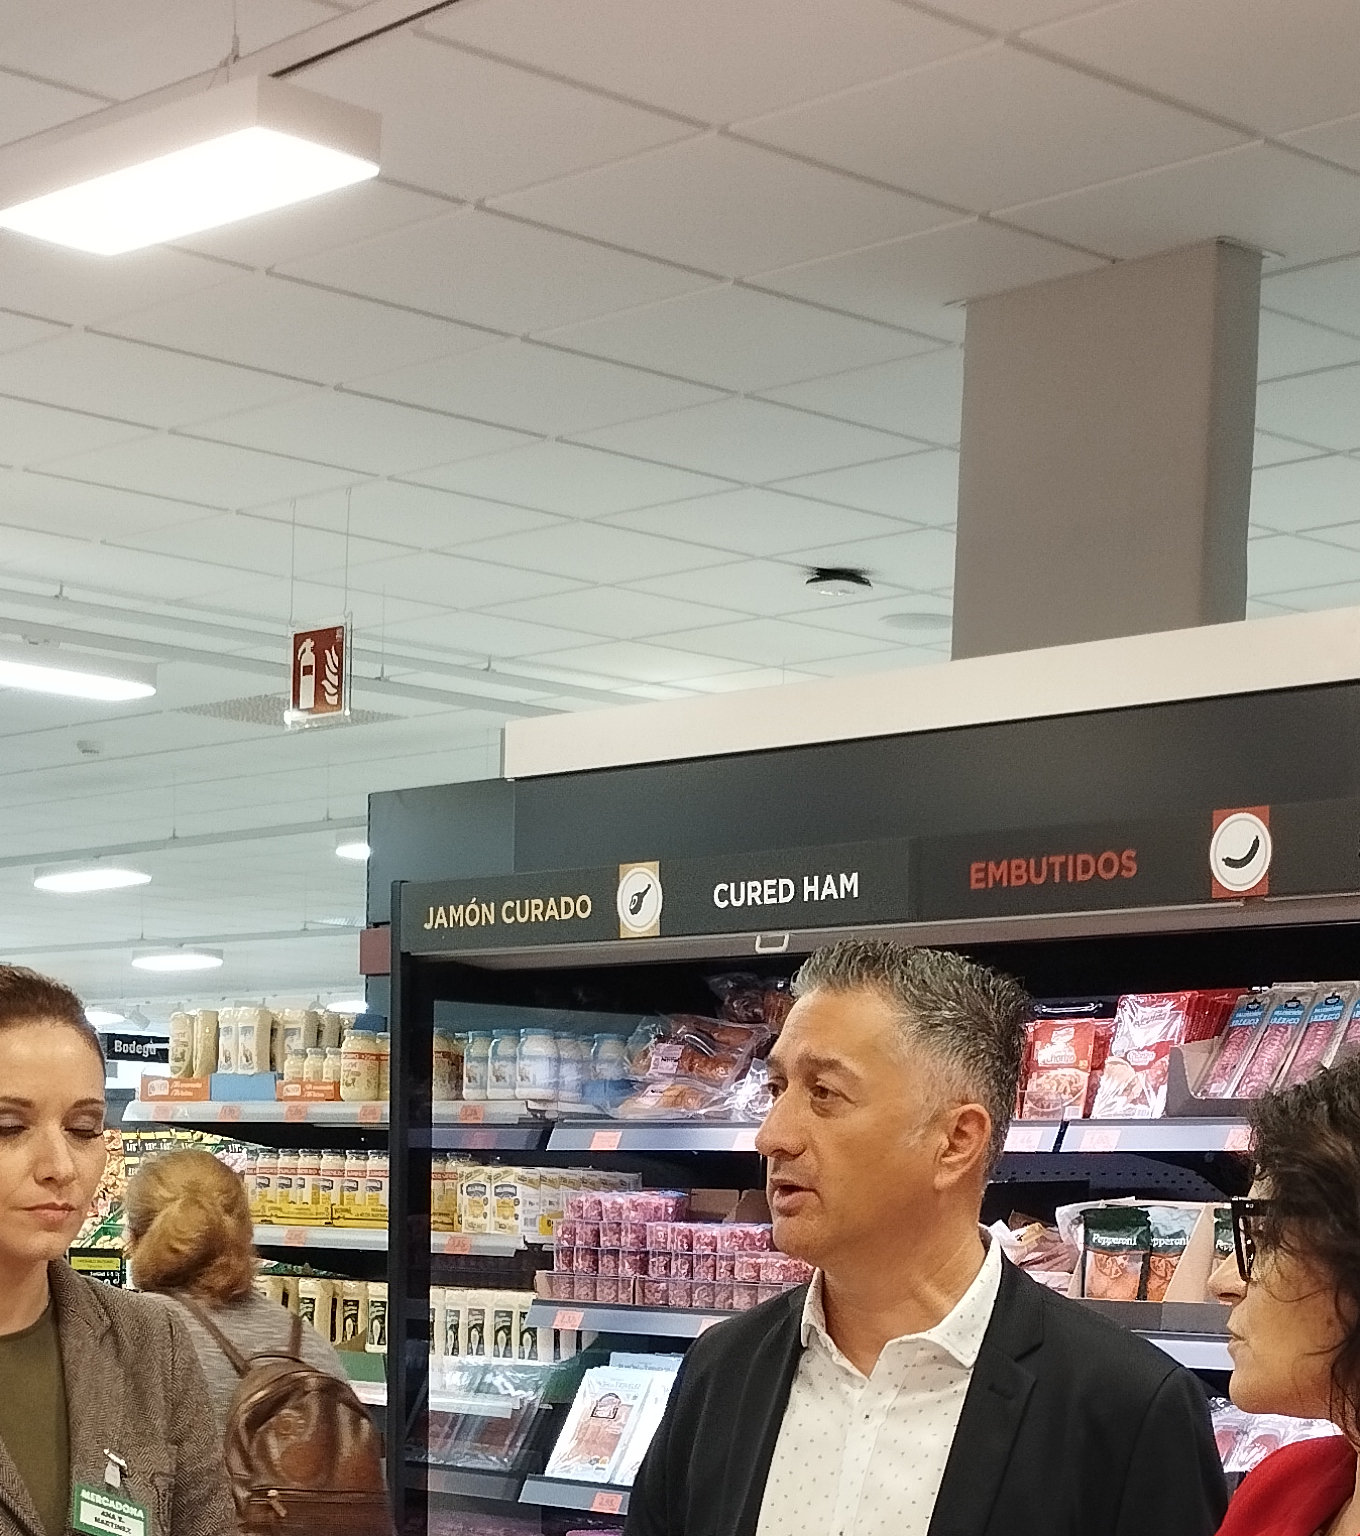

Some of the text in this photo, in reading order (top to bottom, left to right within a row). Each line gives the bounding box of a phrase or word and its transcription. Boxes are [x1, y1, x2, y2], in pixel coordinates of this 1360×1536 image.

[969, 849, 1138, 891] EMBUTIDOS
[713, 872, 860, 909] CURED HAM
[423, 894, 593, 931] JAMÓN CURADO
[80, 1488, 144, 1519] MERCADONA
